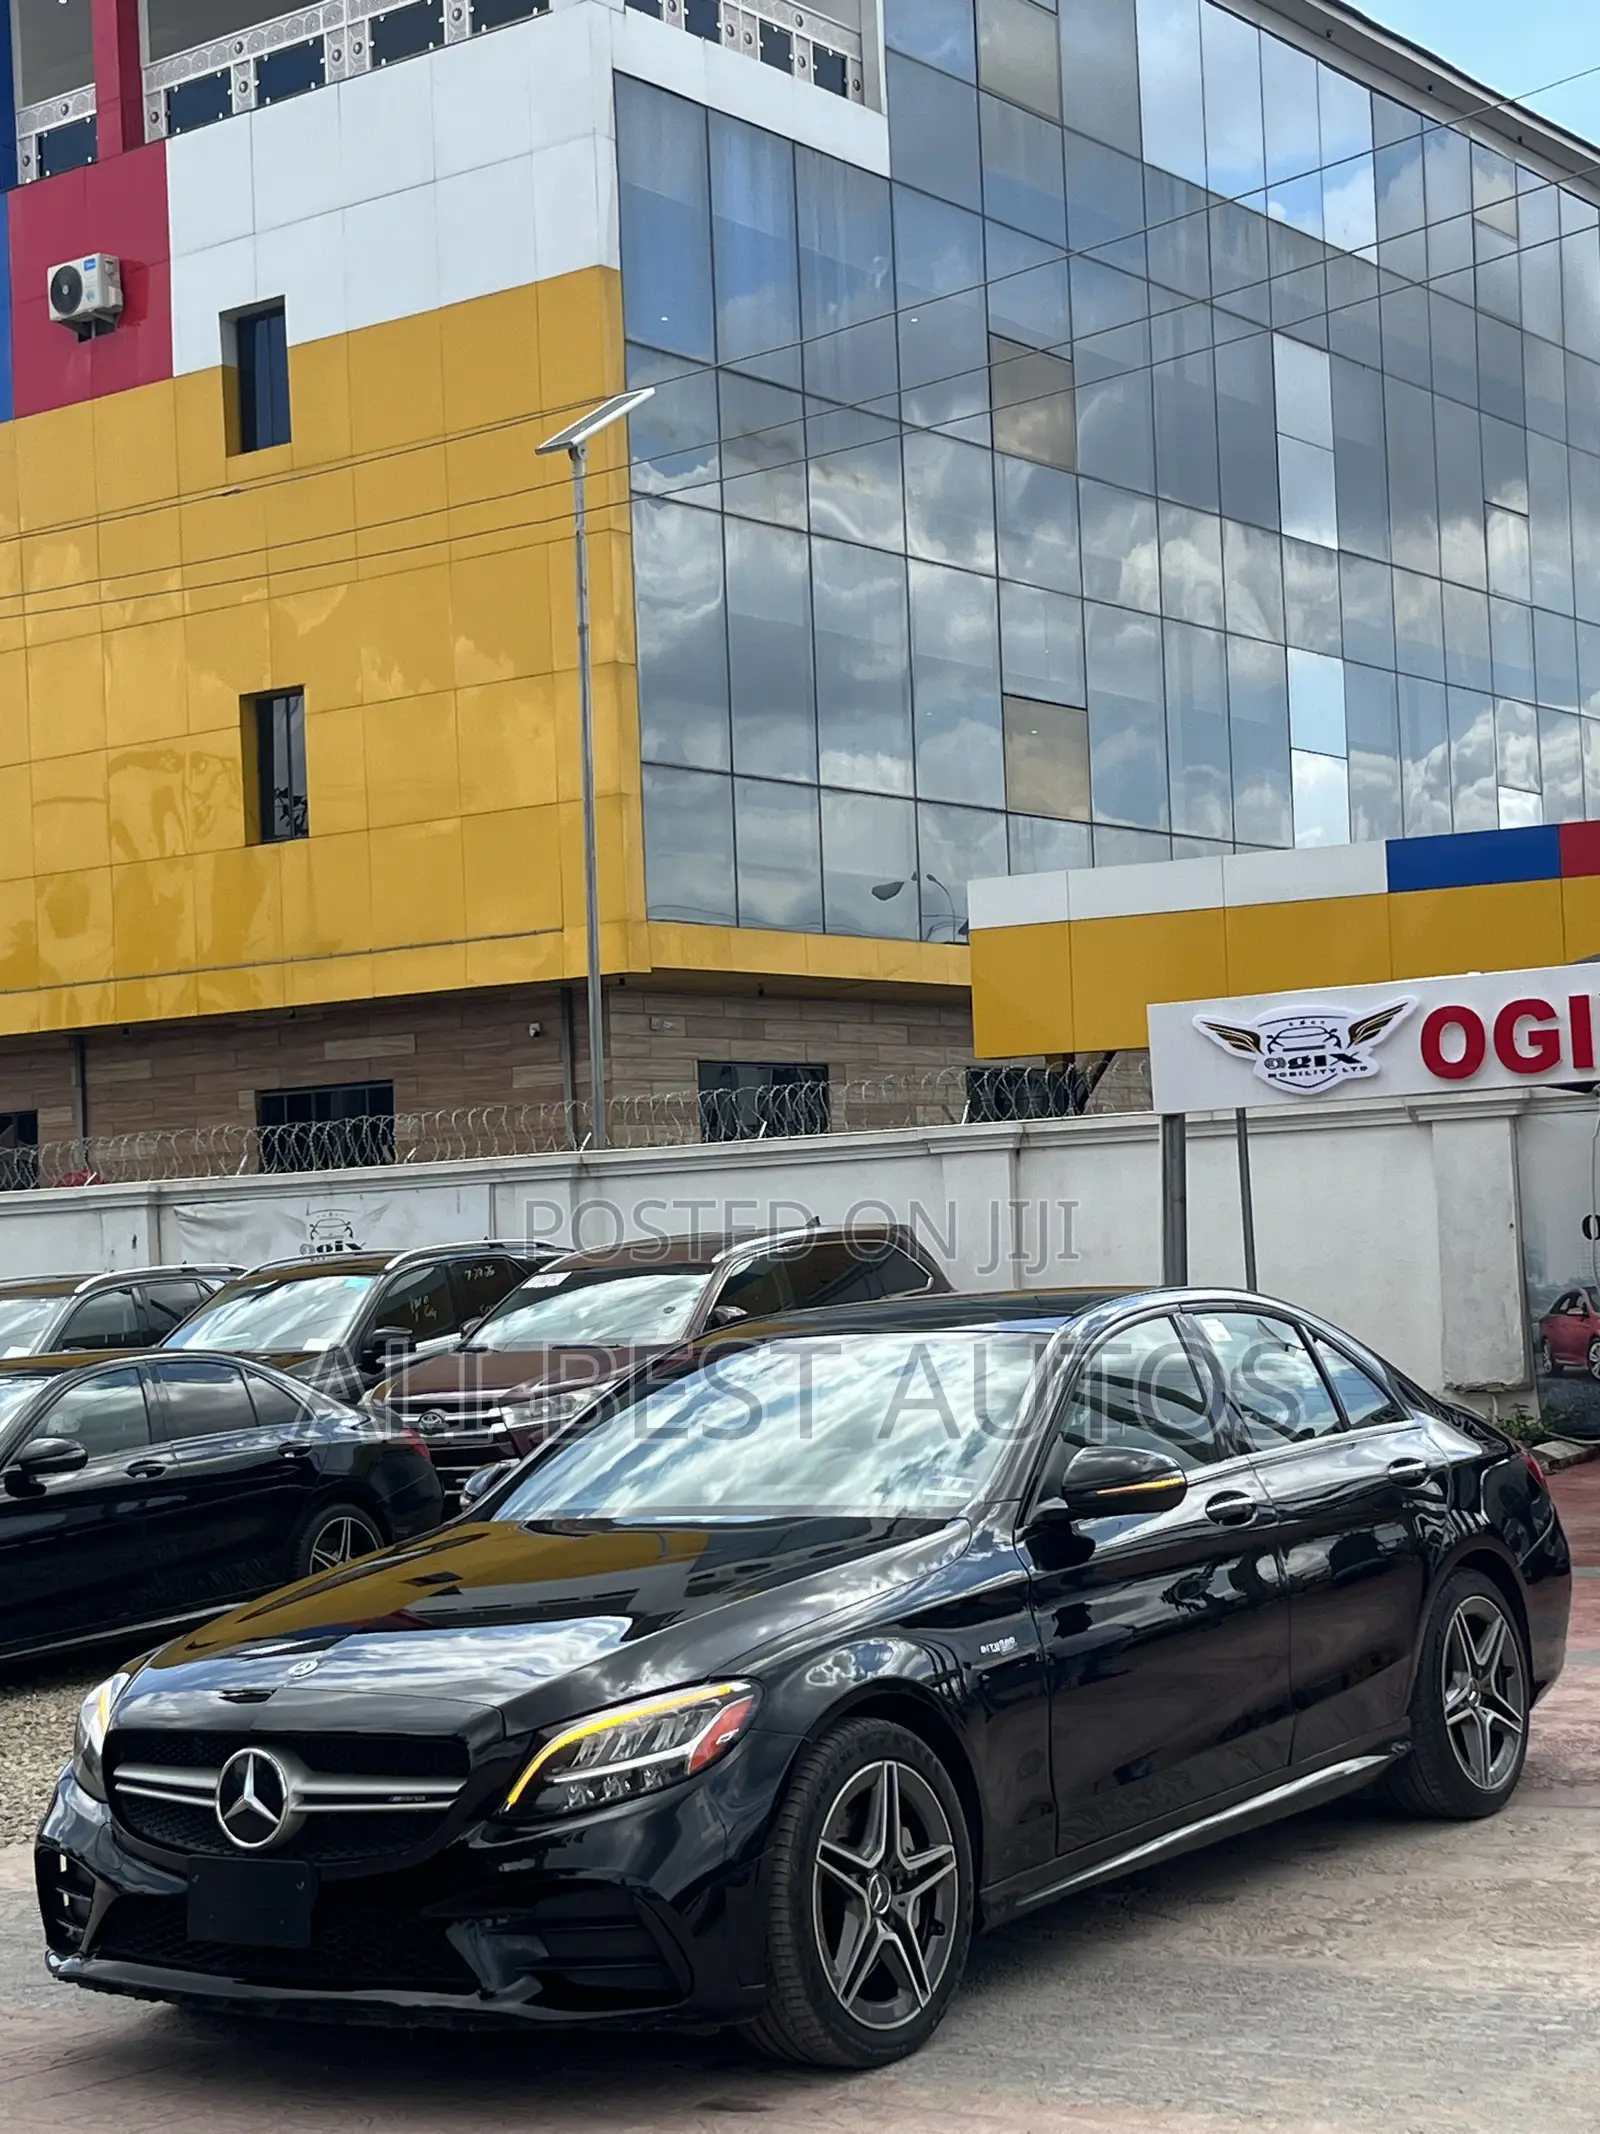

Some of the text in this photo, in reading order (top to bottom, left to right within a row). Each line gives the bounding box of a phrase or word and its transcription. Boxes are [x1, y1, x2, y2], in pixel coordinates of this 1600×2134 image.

[1420, 994, 1595, 1080] OGI
[1267, 1065, 1368, 1079] MOBILITY LTD
